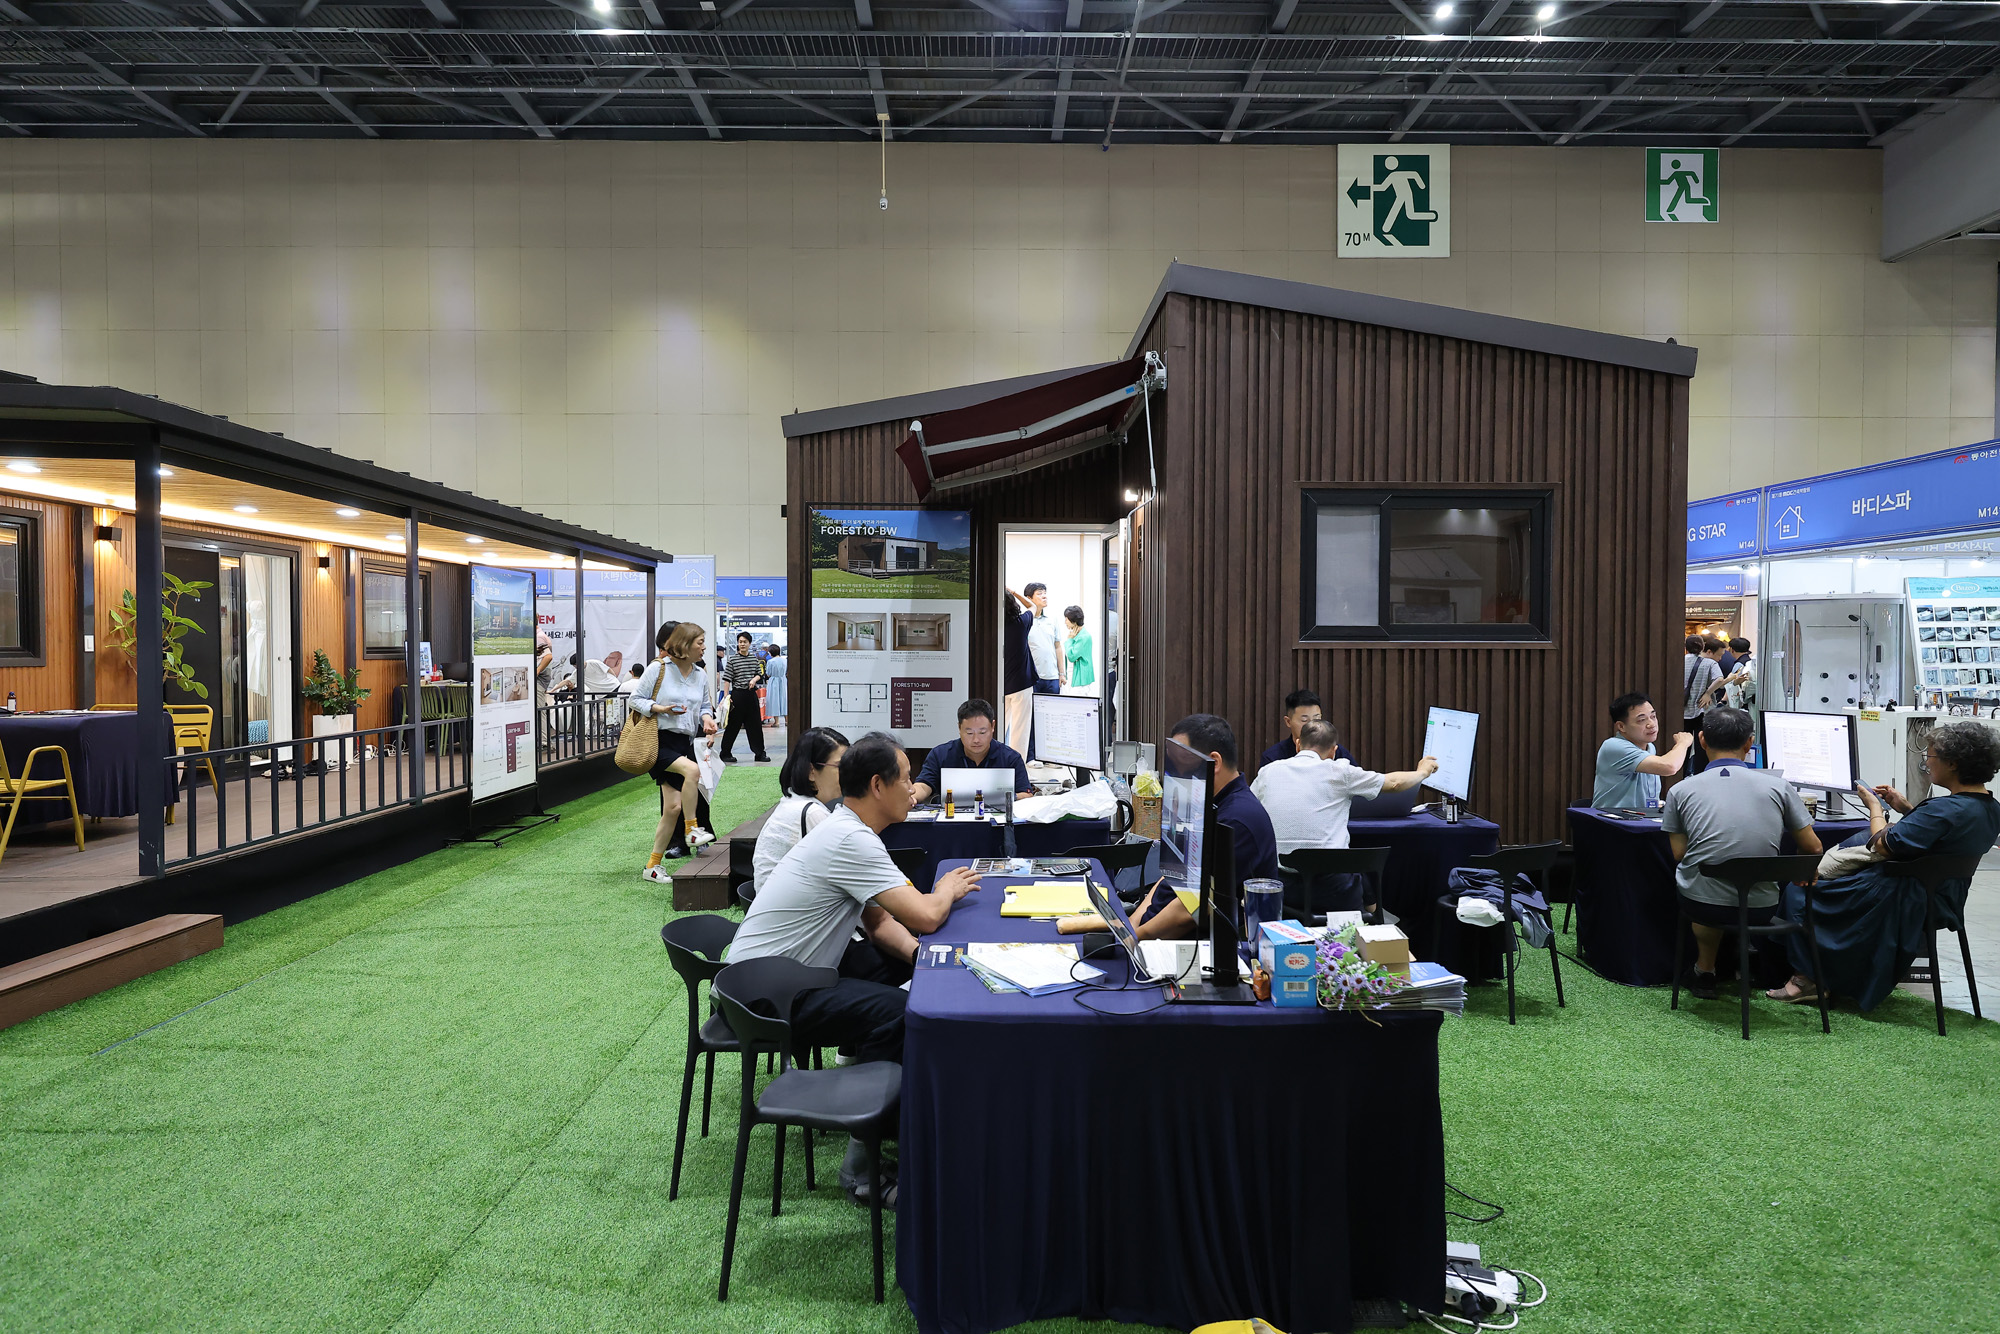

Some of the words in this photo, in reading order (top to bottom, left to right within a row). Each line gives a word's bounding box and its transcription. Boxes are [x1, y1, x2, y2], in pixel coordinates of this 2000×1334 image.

[1970, 448, 2000, 461] 동아전
[1851, 489, 1912, 517] 바디스파
[1978, 505, 2000, 518] M14
[820, 526, 898, 536] FOREST10-BW
[1698, 522, 1727, 541] STAR
[1738, 539, 1755, 549] M144
[744, 588, 774, 597] 홈드레인
